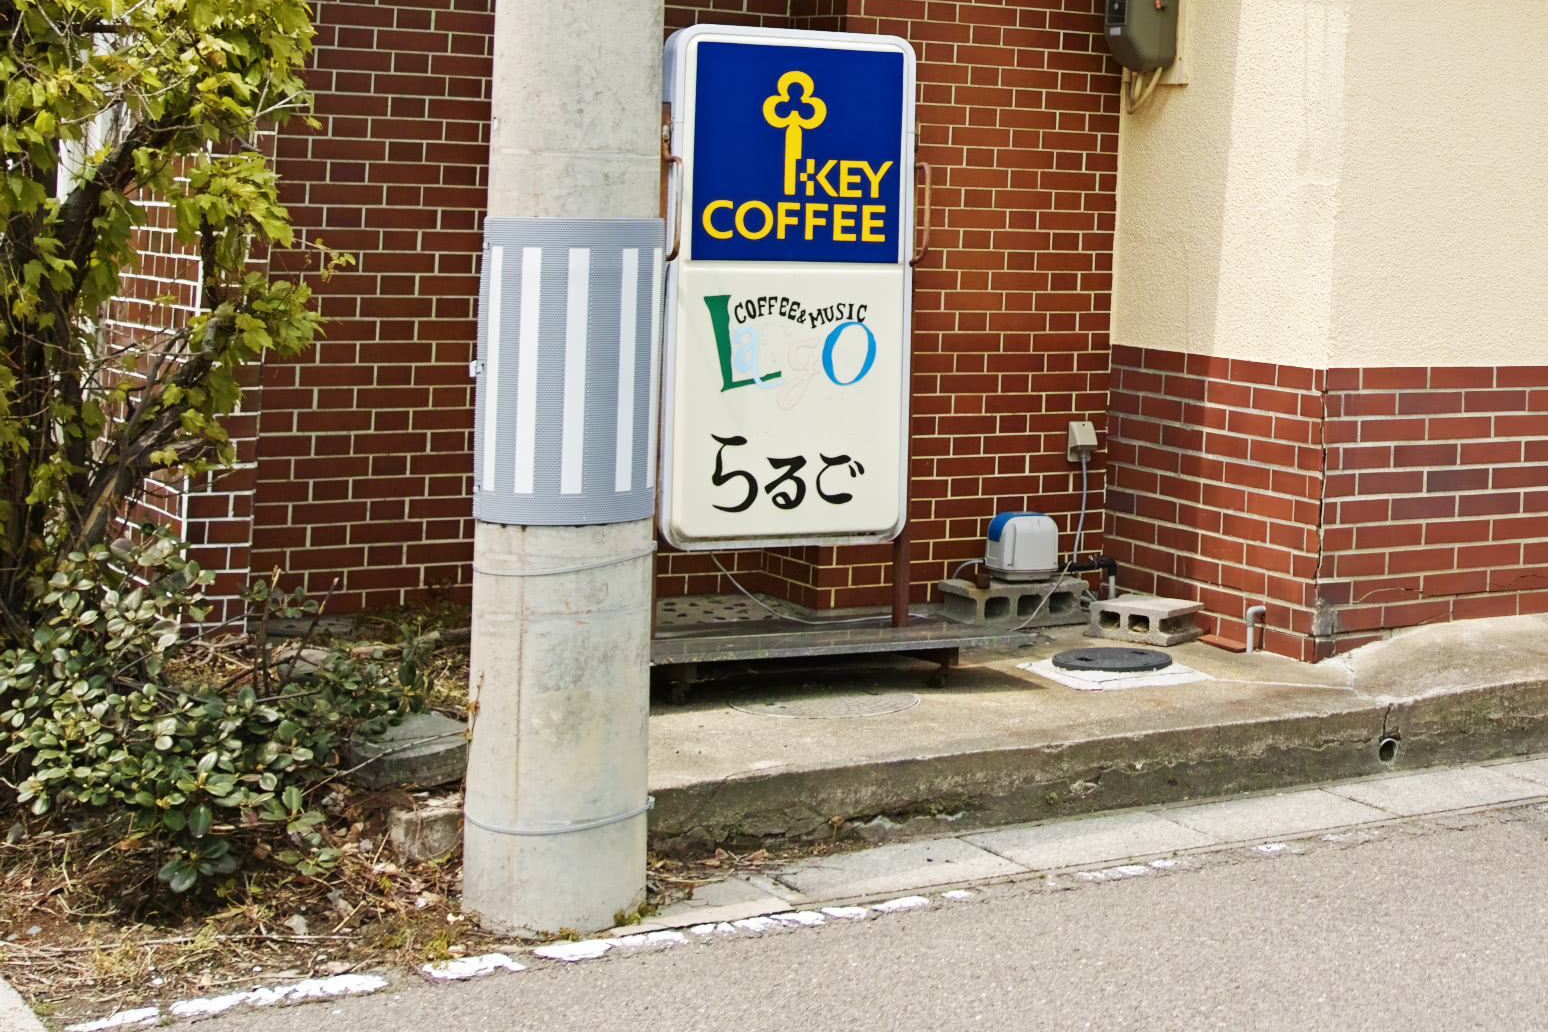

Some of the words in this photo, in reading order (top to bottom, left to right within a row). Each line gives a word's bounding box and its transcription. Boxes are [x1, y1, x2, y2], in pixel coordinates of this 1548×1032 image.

[800, 159, 894, 199] KEY
[702, 199, 887, 243] COFFEE
[734, 296, 867, 329] COFFEE&MUSIC
[711, 433, 865, 513] らるご
